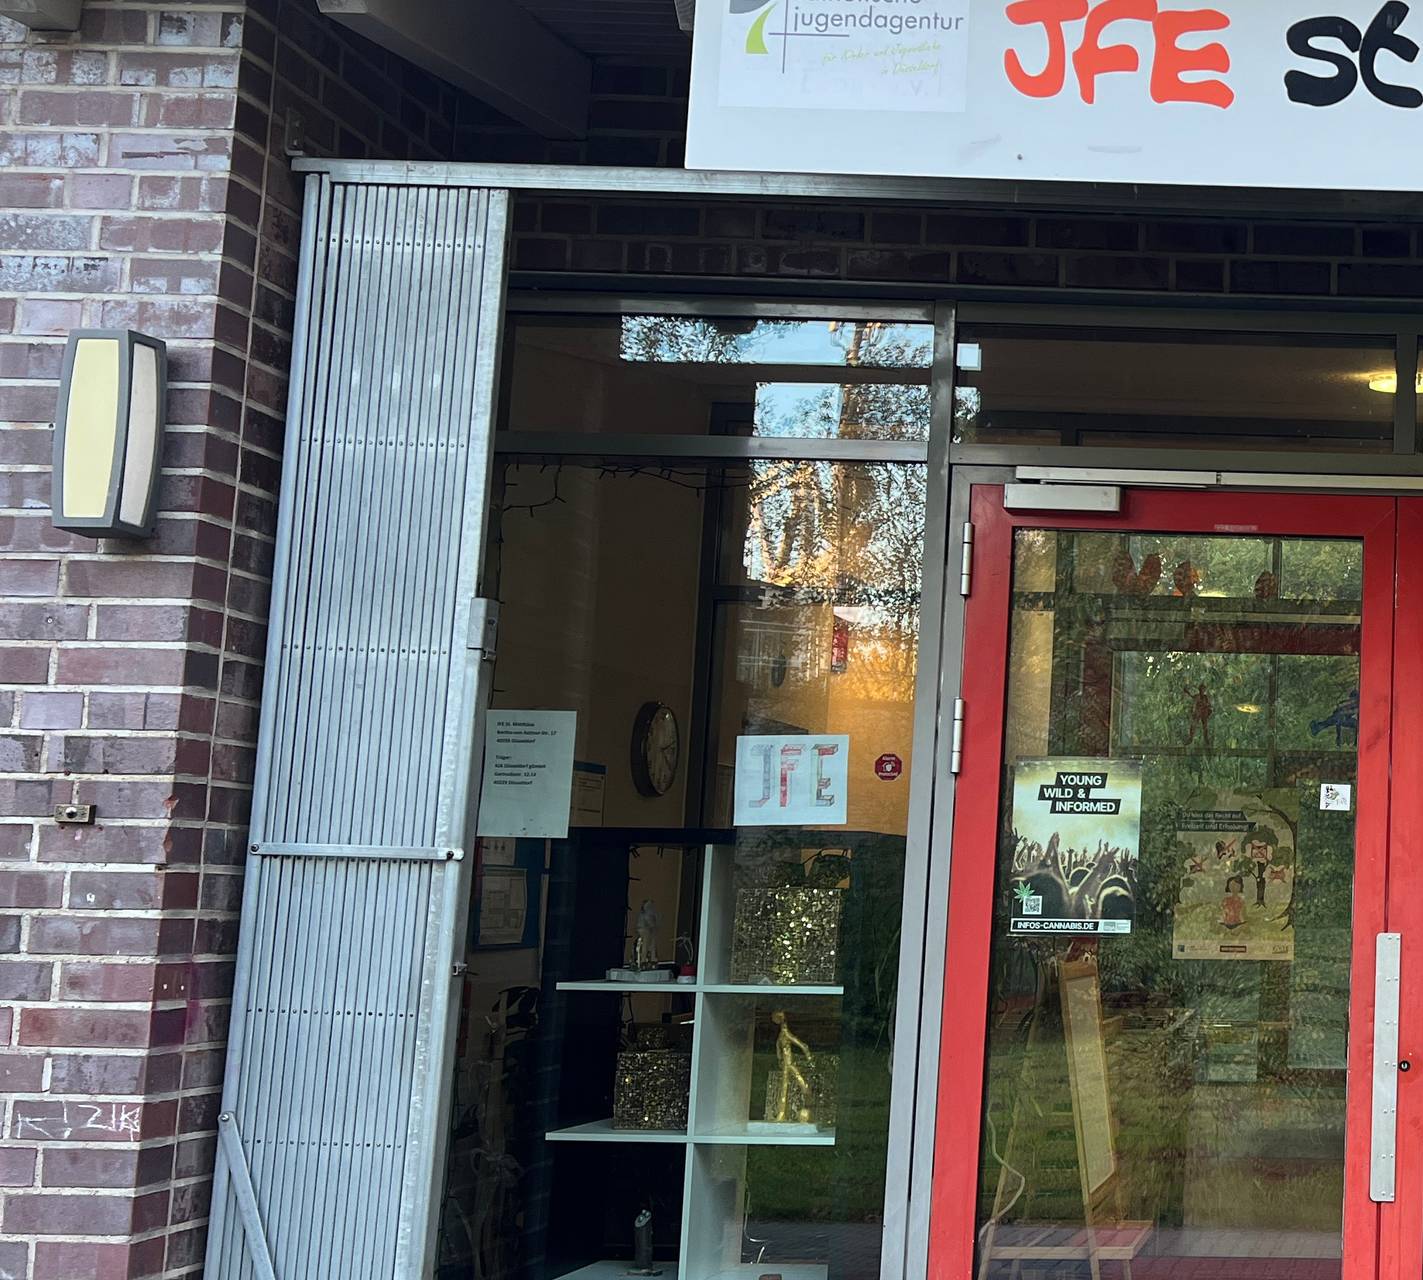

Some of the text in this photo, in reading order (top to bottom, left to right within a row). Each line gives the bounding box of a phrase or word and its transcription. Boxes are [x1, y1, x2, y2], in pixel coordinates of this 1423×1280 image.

[794, 5, 965, 35] jugendagentur
[1004, 0, 1234, 109] JFE
[749, 743, 839, 808] JFE
[1060, 774, 1103, 786] YOUNG
[1043, 787, 1086, 799] WILD &
[1055, 801, 1116, 813] INFORMED
[1017, 921, 1094, 930] INFOS-CANNABIS.DE
